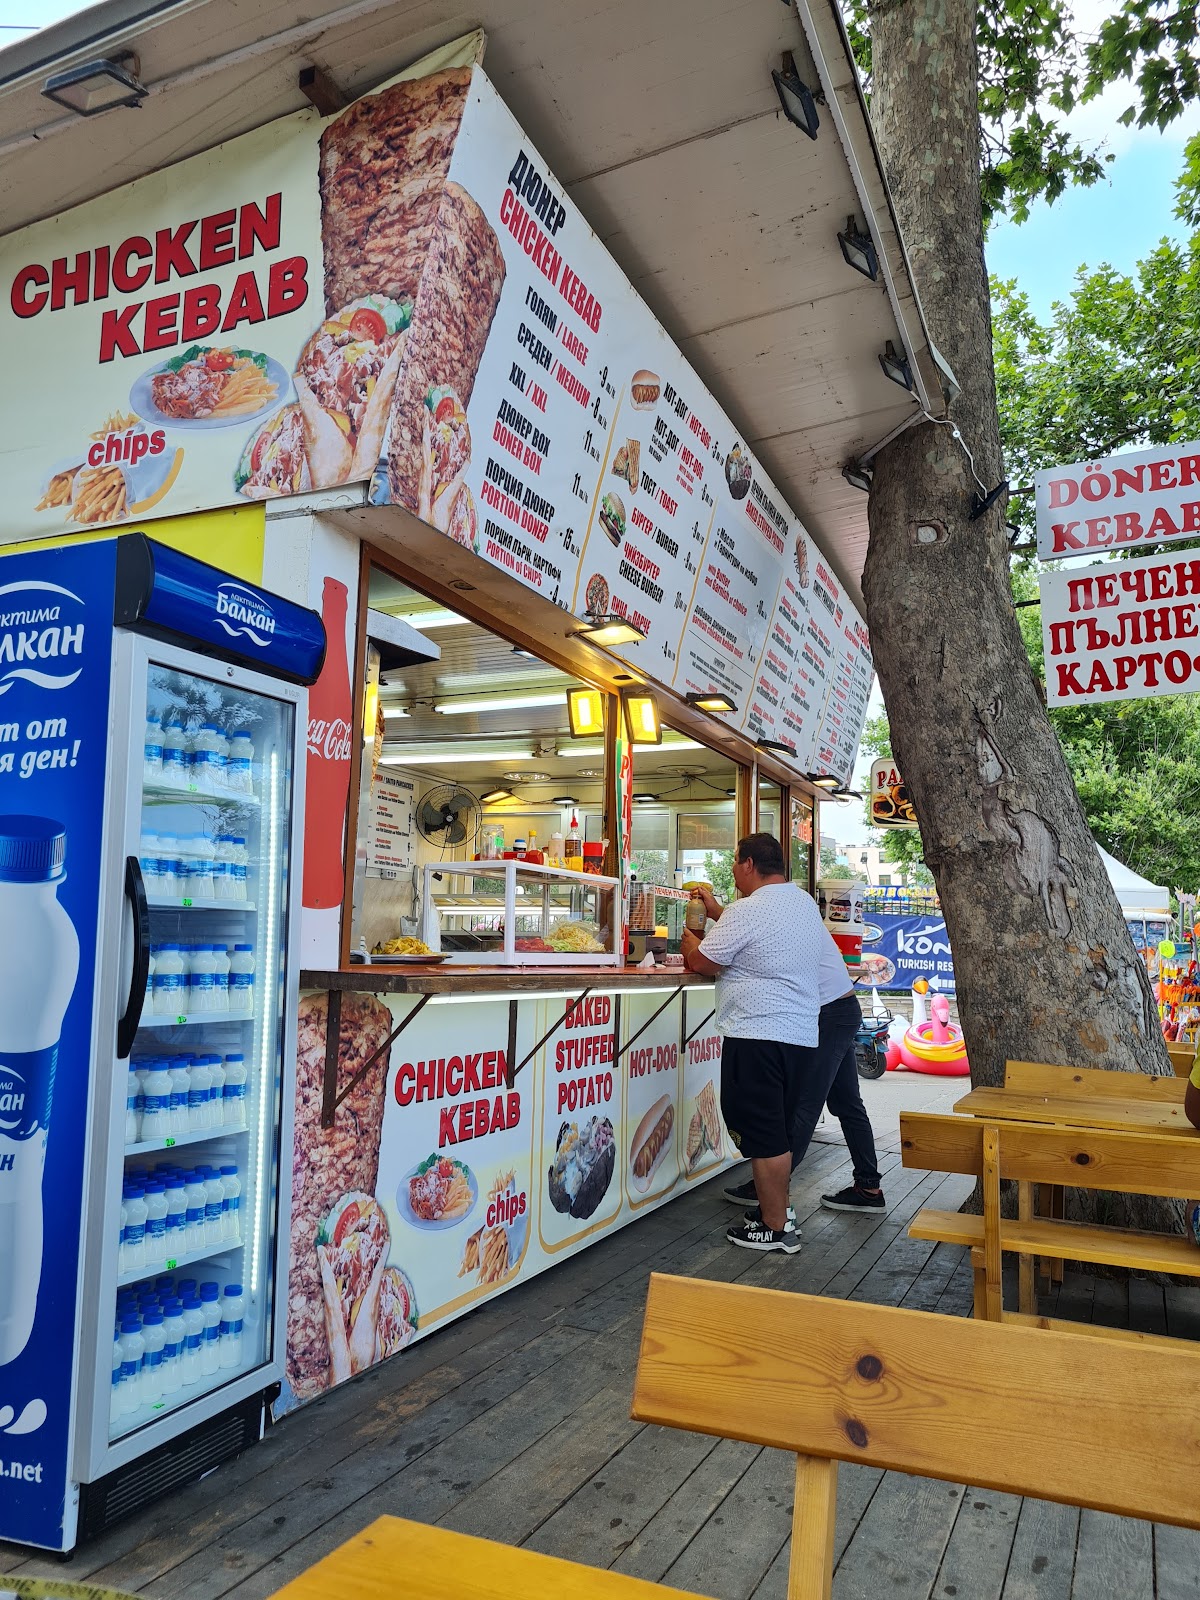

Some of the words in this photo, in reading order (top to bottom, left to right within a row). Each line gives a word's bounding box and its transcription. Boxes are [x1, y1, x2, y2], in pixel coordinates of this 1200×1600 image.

[507, 149, 566, 237] ДЮНЕР
[10, 192, 282, 319] CHICKEN
[500, 188, 563, 286] CHICKEN
[559, 264, 603, 334] KEBAB
[99, 256, 309, 364] KEBAB
[525, 285, 558, 334] ГОЛЯМ
[561, 326, 589, 367] LARGE
[509, 361, 526, 393] XXL
[531, 383, 548, 413] XXL
[517, 322, 552, 371] СРЕДЕН
[556, 363, 591, 409] MEDIUM
[87, 430, 166, 468] chips
[492, 420, 524, 461] DONER
[522, 446, 542, 476] BOX
[497, 398, 532, 440] ДЮНЕР
[531, 427, 551, 457] BOX
[689, 414, 712, 450] HOT-DOG
[681, 446, 704, 480] HOT-DOG
[1048, 454, 1200, 510] DÖNER
[480, 480, 521, 524] PORTION
[520, 509, 549, 543] DONER
[485, 457, 523, 501] ПОРЦИЯ
[522, 487, 555, 523] ДЮНЕР
[640, 470, 656, 497] ТОСТ
[659, 490, 678, 517] TOAST
[484, 518, 512, 549] ПОРЦИЯ
[533, 552, 561, 583] КАРТОФИ
[631, 507, 653, 536] БУРГЕР
[655, 529, 679, 559] BURGER
[1051, 501, 1200, 553] KEBAB
[486, 539, 515, 570] PORTION
[515, 562, 522, 575] of
[523, 563, 542, 587] CHIPS
[619, 559, 641, 588] CHEESE
[640, 576, 664, 604] BURGER
[624, 541, 661, 581] ЧИЙЗБУРГЕР
[231, 593, 265, 613] лактима
[1067, 560, 1200, 613] ПЕЧЕН
[216, 591, 275, 634] Балкан
[1049, 603, 1200, 656] ПЪЛНЕ
[1056, 650, 1200, 697] КАРТО
[26, 717, 67, 740] от
[19, 739, 82, 779] ден!
[897, 958, 934, 971] TURKISH
[565, 995, 611, 1029] BAKED
[630, 1043, 677, 1079] HOT-DOG
[688, 1035, 721, 1065] TOASTS
[558, 1072, 613, 1115] POTATO
[439, 1092, 521, 1148] KEBAB
[486, 1190, 526, 1227] chips
